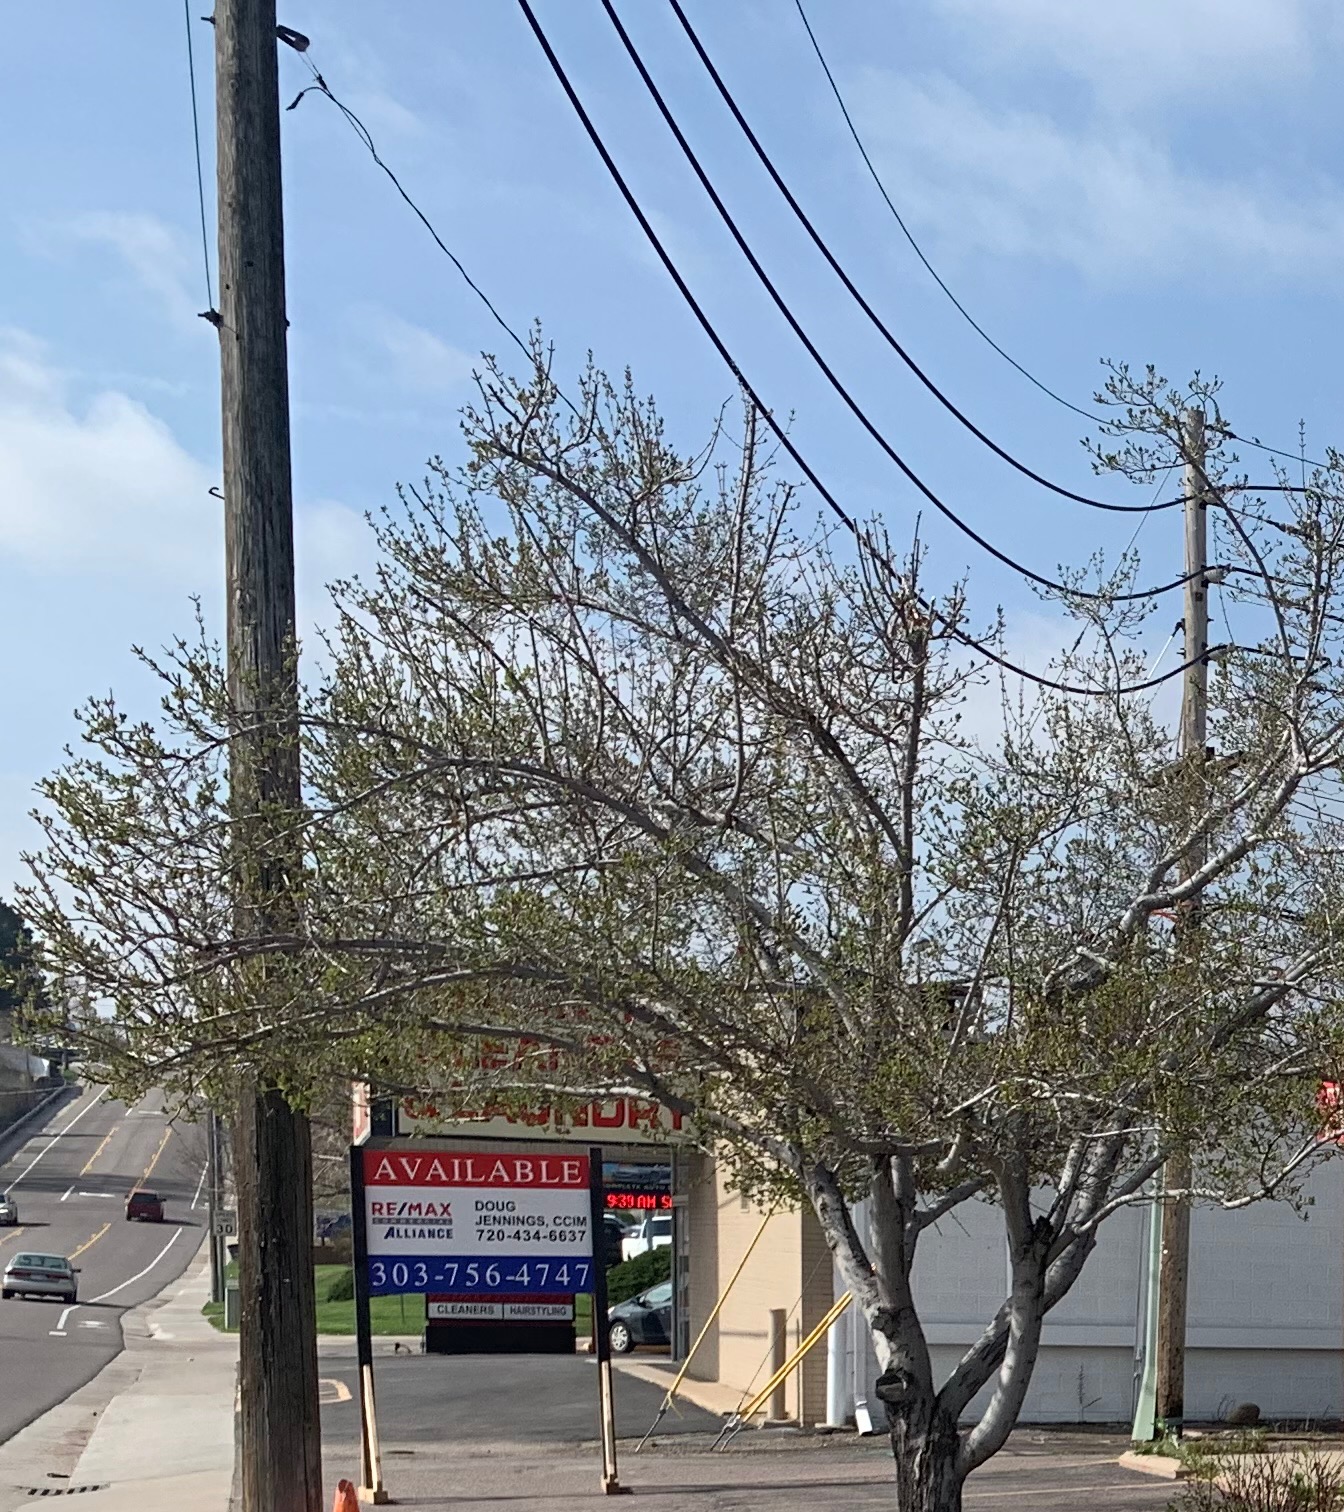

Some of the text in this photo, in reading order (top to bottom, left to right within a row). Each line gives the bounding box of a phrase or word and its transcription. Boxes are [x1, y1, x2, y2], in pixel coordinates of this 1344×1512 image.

[373, 1156, 582, 1184] AVAILABLE
[475, 1201, 516, 1212] DOUG
[637, 1195, 656, 1208] AM
[372, 1202, 452, 1217] RE/MAX
[475, 1216, 587, 1228] JENNINGS, CCIM
[216, 1224, 233, 1234] 30
[384, 1227, 453, 1239] ALLIANCE
[372, 1263, 589, 1287] 303-756-4747
[437, 1305, 567, 1316] CLEANERS HAIRSTYLING
